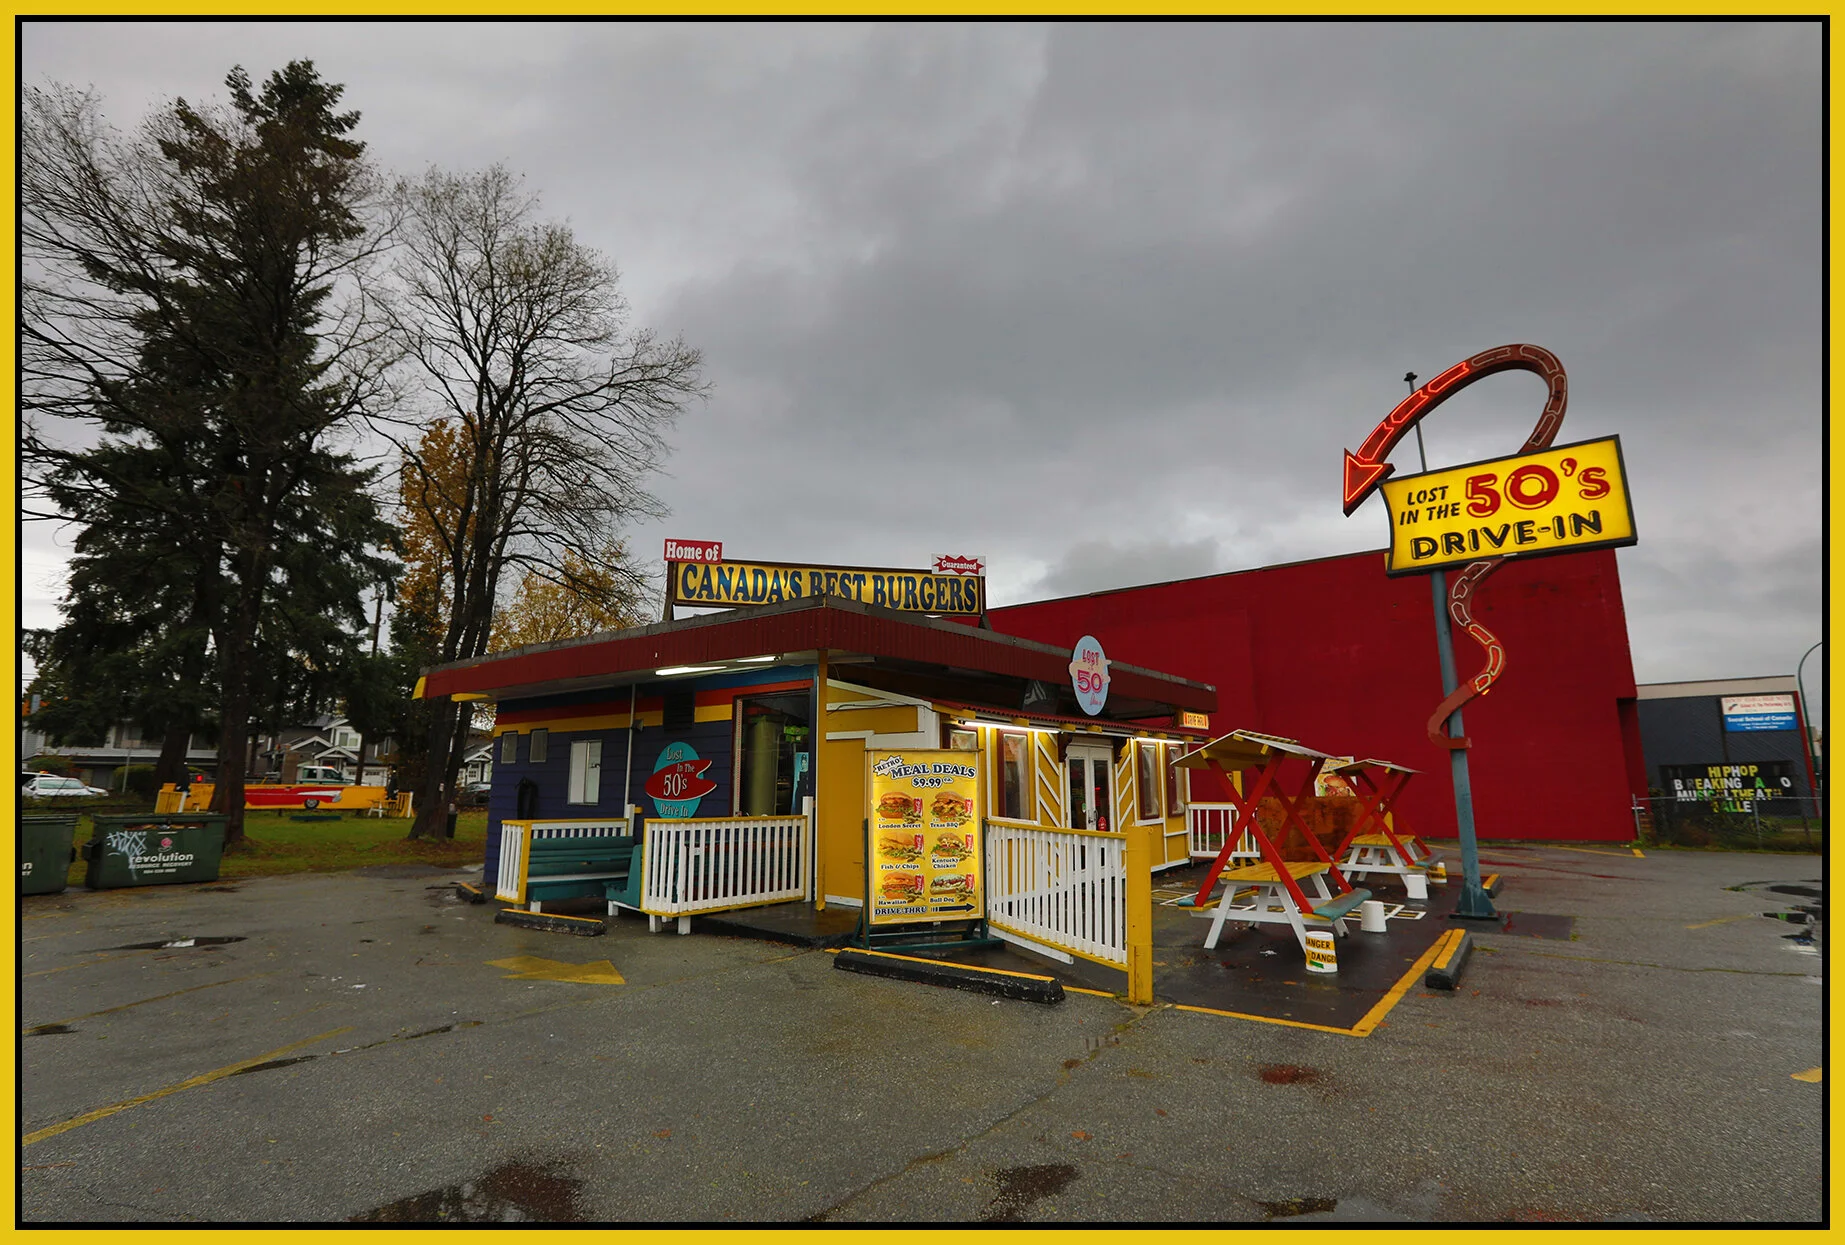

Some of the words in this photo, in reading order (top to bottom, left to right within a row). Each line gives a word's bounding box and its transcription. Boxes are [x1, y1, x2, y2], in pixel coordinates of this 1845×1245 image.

[1465, 457, 1611, 518] 50's
[1406, 485, 1449, 506] LOST
[1399, 508, 1419, 526] IN
[1426, 502, 1461, 521] THE
[1410, 509, 1603, 560] DRIVE-IN
[665, 541, 702, 560] Home
[704, 545, 720, 561] of
[941, 559, 977, 570] Guaranteed
[681, 563, 803, 602] CANADA'S
[809, 571, 866, 602] BEST
[872, 574, 977, 612] BURGERS
[667, 747, 683, 760] Lost
[684, 763, 695, 773] The
[876, 757, 901, 772] RETRO
[890, 764, 930, 779] MEAL
[932, 764, 976, 778] DEALS
[663, 773, 688, 797] 50's
[912, 776, 941, 788] $9.99
[660, 803, 680, 816] Drive
[680, 805, 689, 817] In
[129, 852, 194, 863] revolution
